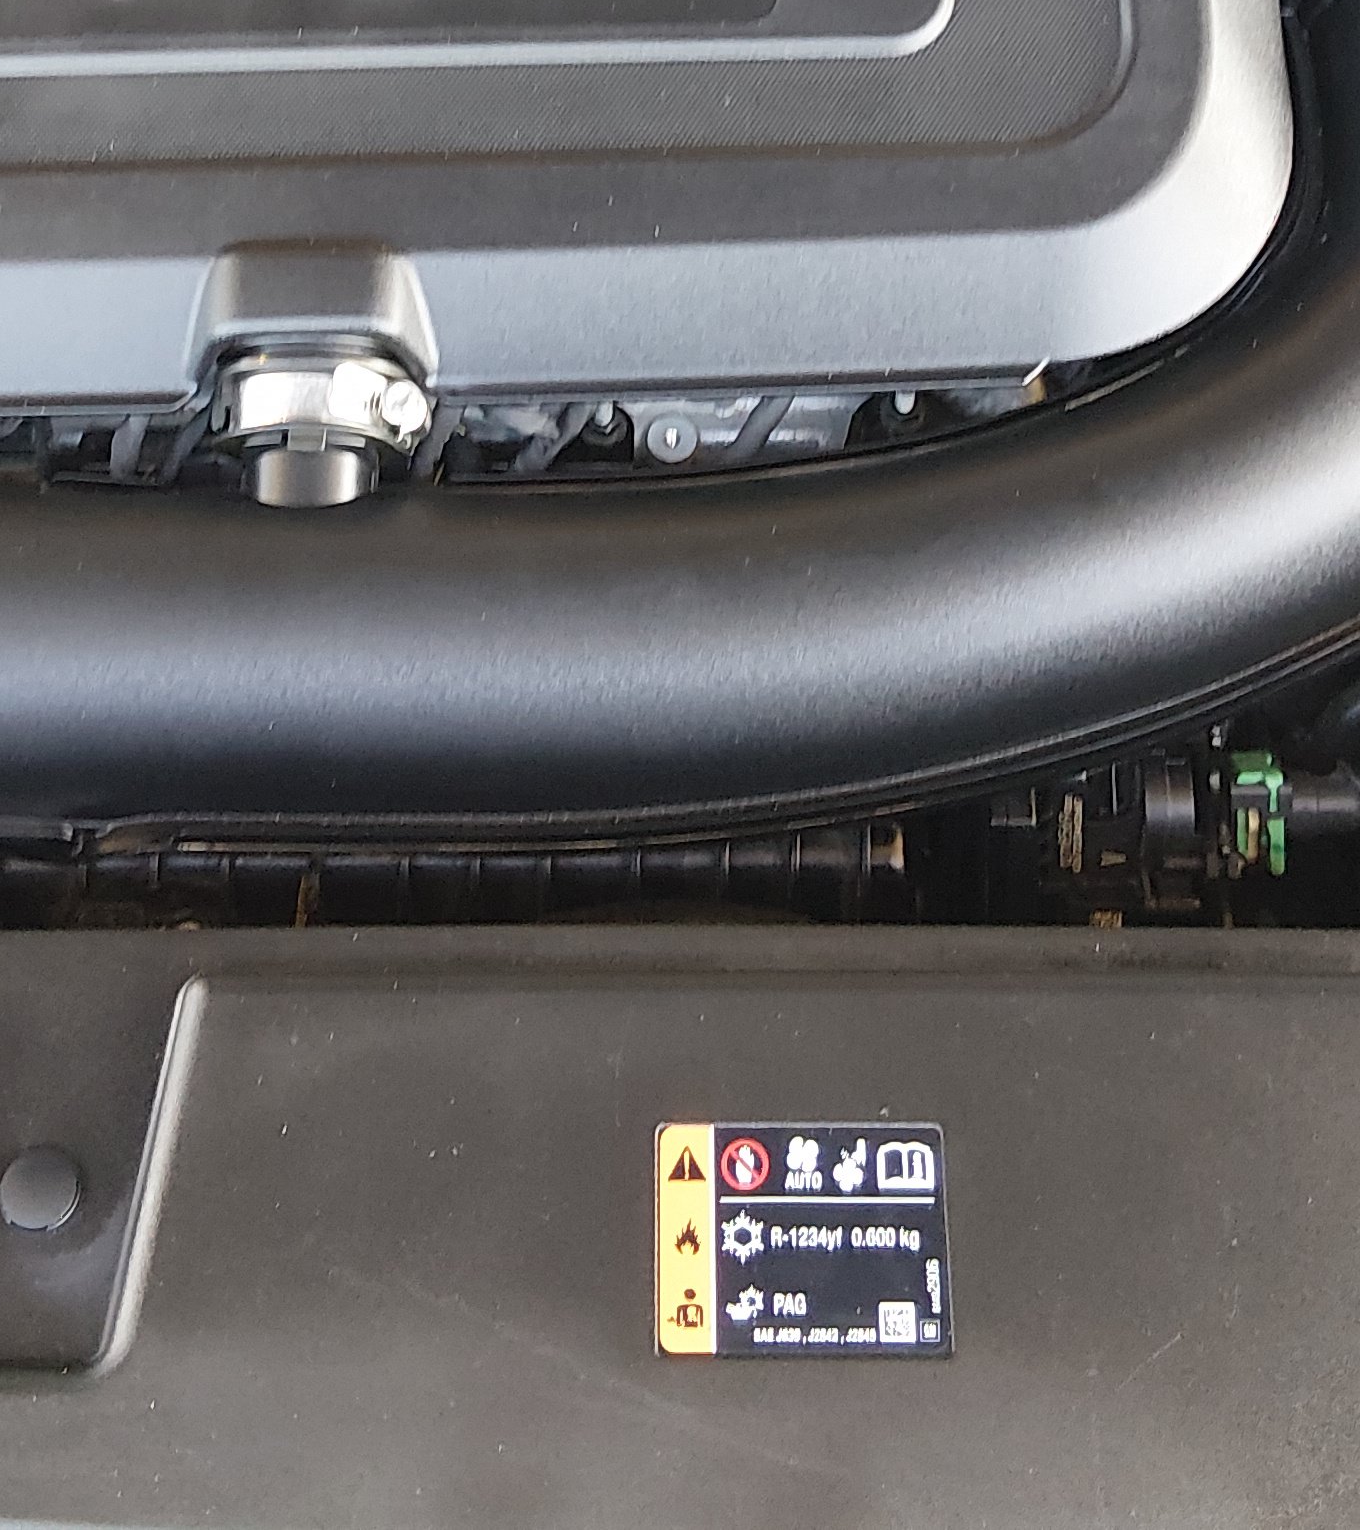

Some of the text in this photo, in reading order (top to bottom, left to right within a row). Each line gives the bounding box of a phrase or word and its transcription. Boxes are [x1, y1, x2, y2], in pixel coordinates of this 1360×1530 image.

[784, 1171, 823, 1190] AUTO
[770, 1225, 843, 1252] R-1234yf
[899, 1225, 920, 1252] kg
[772, 1292, 807, 1316] PAG
